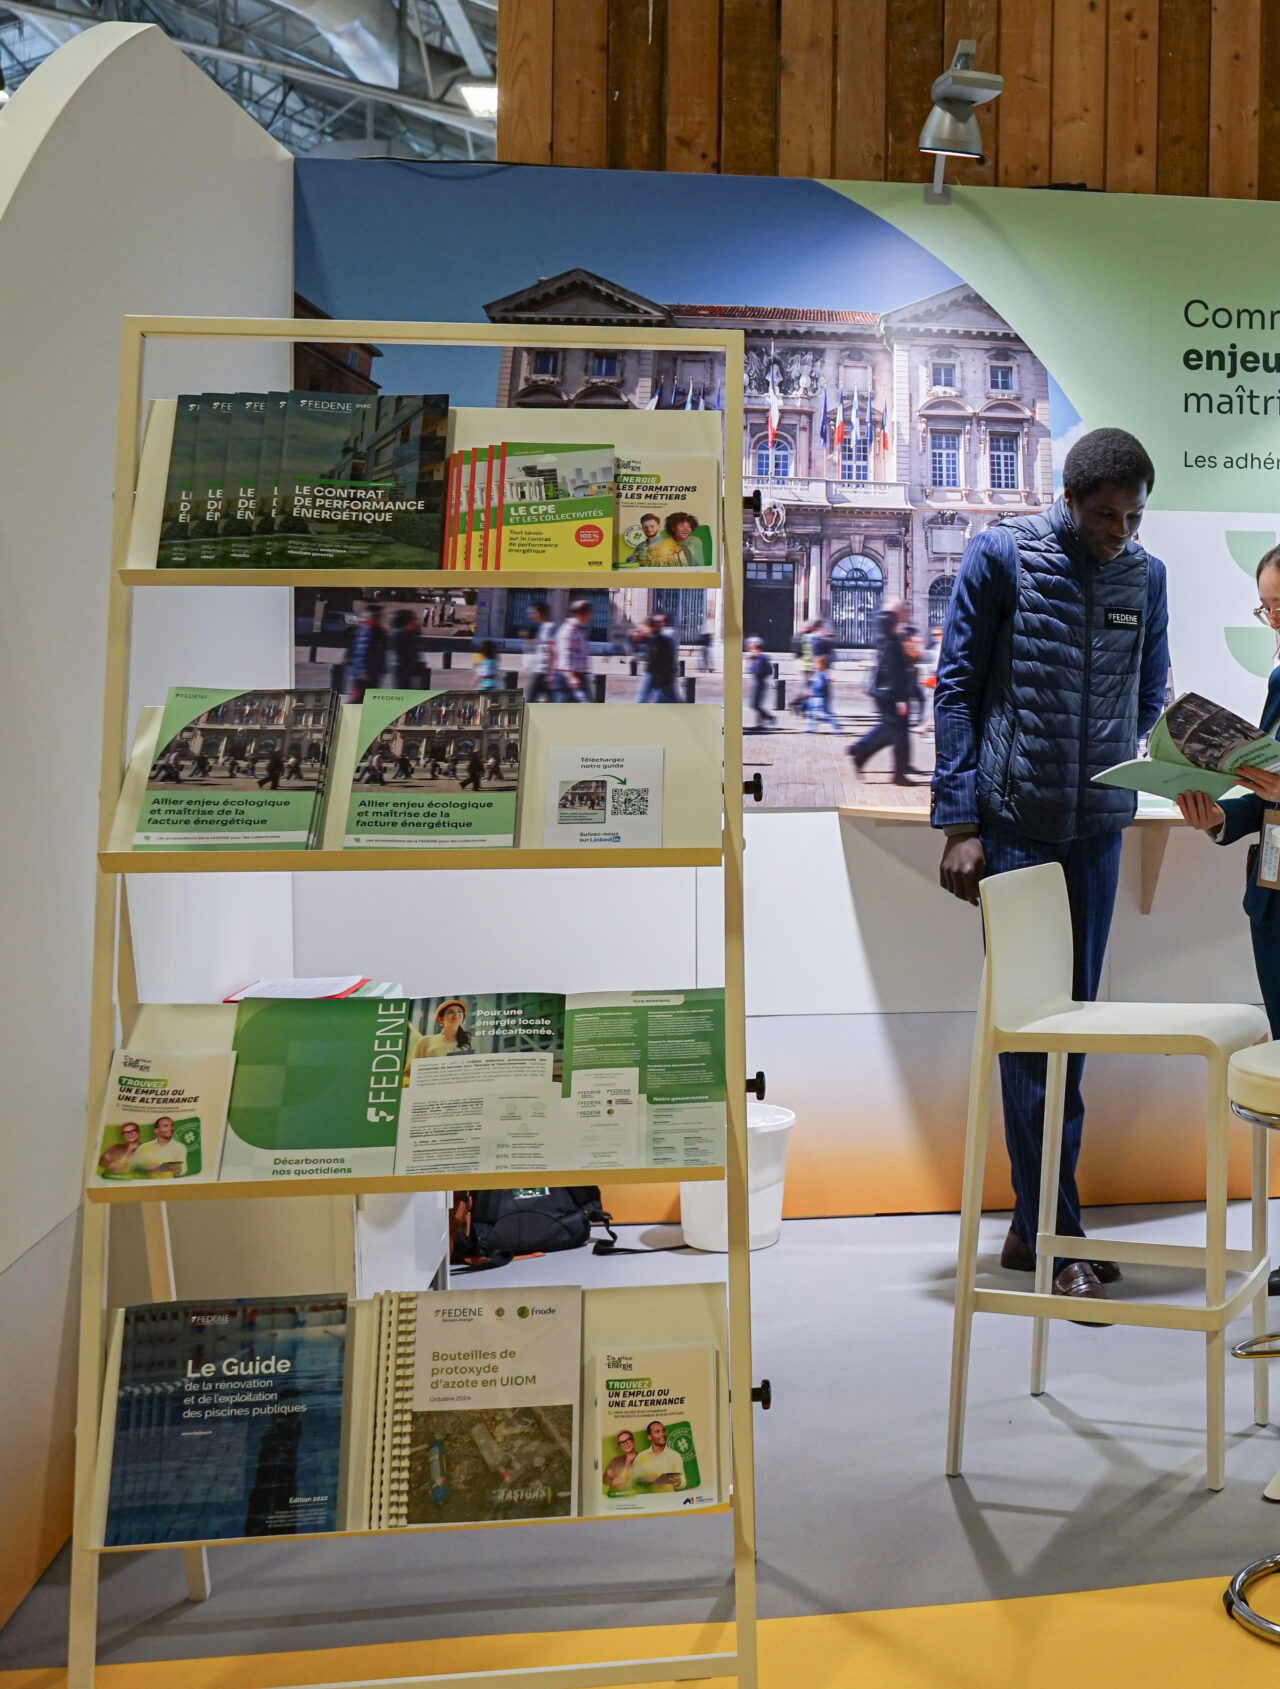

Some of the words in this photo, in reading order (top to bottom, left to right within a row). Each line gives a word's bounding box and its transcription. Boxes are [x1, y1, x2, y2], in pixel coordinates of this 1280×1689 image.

[308, 400, 352, 411] FEDENE
[1183, 451, 1217, 470] Les
[208, 489, 224, 498] LE
[239, 488, 255, 498] LE
[295, 485, 310, 496] LE
[314, 486, 384, 499] CONTRAT
[616, 484, 634, 492] LES
[635, 485, 697, 493] FORMATIONS
[624, 492, 640, 500] LES
[643, 490, 687, 501] MÉTIERS
[238, 499, 256, 508] DE
[294, 496, 312, 507] DE
[315, 498, 425, 510] PERFORMANCE
[292, 506, 393, 523] ÉNERGÉTIQUE
[510, 506, 527, 517] LE
[529, 503, 556, 516] CPE
[510, 515, 520, 523] ET
[523, 514, 539, 523] LES
[540, 508, 604, 522] COLLECTIVITÉS
[1112, 613, 1138, 622] FEDENE
[151, 798, 184, 806] Allier
[186, 799, 220, 808] enjeu
[222, 798, 291, 809] écologique
[358, 799, 390, 808] Allier
[392, 801, 425, 810] enjeu
[427, 799, 494, 811] écologique
[165, 807, 215, 816] maîtrise
[217, 808, 232, 816] de
[234, 808, 245, 816] la
[357, 810, 368, 818] et
[372, 808, 419, 818] maîtrise
[422, 810, 437, 818] de
[440, 810, 450, 818] la
[147, 817, 191, 826] facture
[193, 816, 268, 827] énergétique
[356, 819, 398, 828] facture
[400, 819, 472, 830] énergétique
[476, 1009, 500, 1018] Pour
[502, 1009, 523, 1017] une
[475, 1018, 515, 1028] énergie
[518, 1017, 551, 1026] locale
[475, 1028, 486, 1036] et
[488, 1026, 555, 1037] décarbonée.
[368, 1001, 406, 1103] FEDENE
[121, 1077, 165, 1088] TROUVEZ
[119, 1086, 133, 1094] UN
[135, 1088, 169, 1096] EMPLOI
[118, 1094, 138, 1103] UNE
[139, 1096, 200, 1104] ALTERNANCE
[273, 1156, 345, 1166] Décarbonons
[294, 1166, 352, 1177] quotidiens
[442, 1307, 483, 1318] FEDENE
[530, 1307, 557, 1316] fnade
[197, 1314, 230, 1323] FEDENE
[432, 1350, 497, 1362] Bouteilles
[499, 1349, 516, 1359] de
[186, 1359, 216, 1378] Le
[222, 1356, 291, 1376] Guide
[431, 1364, 499, 1377] protoxyde
[184, 1381, 200, 1392] de
[202, 1380, 212, 1391] la
[215, 1378, 273, 1391] rénovation
[481, 1378, 497, 1387] en
[500, 1375, 537, 1387] UIOM
[608, 1381, 649, 1389] TROUVEZ
[183, 1395, 195, 1405] et
[198, 1394, 212, 1404] de
[622, 1390, 655, 1398] EMPLOI
[608, 1400, 626, 1408] UNE
[628, 1397, 686, 1408] ALTERNANCE
[182, 1408, 202, 1419] des
[204, 1405, 250, 1420] piscines
[252, 1403, 307, 1417] publiques
